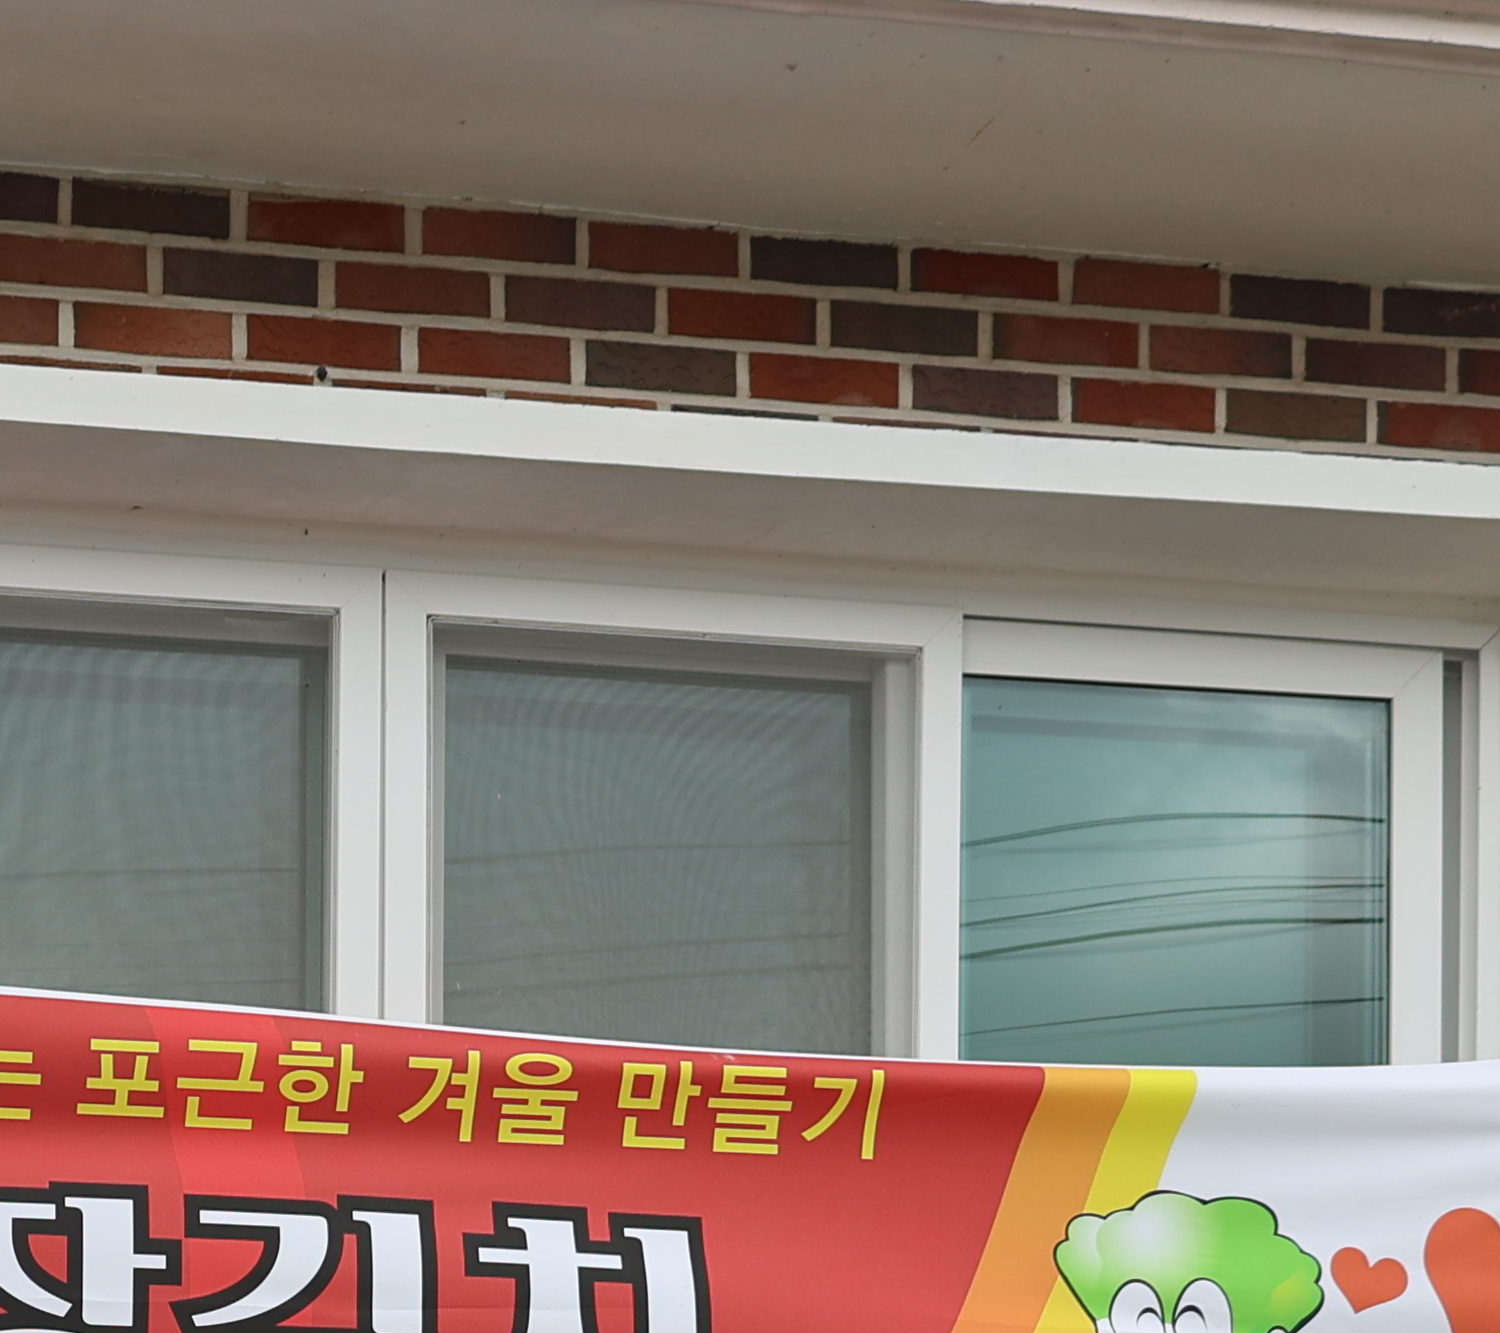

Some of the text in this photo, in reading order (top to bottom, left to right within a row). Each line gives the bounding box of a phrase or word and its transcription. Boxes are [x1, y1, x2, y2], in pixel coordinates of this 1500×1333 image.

[76, 1037, 366, 1136] 포근한
[399, 1050, 580, 1146] 겨울
[617, 1059, 887, 1161] 만들기
